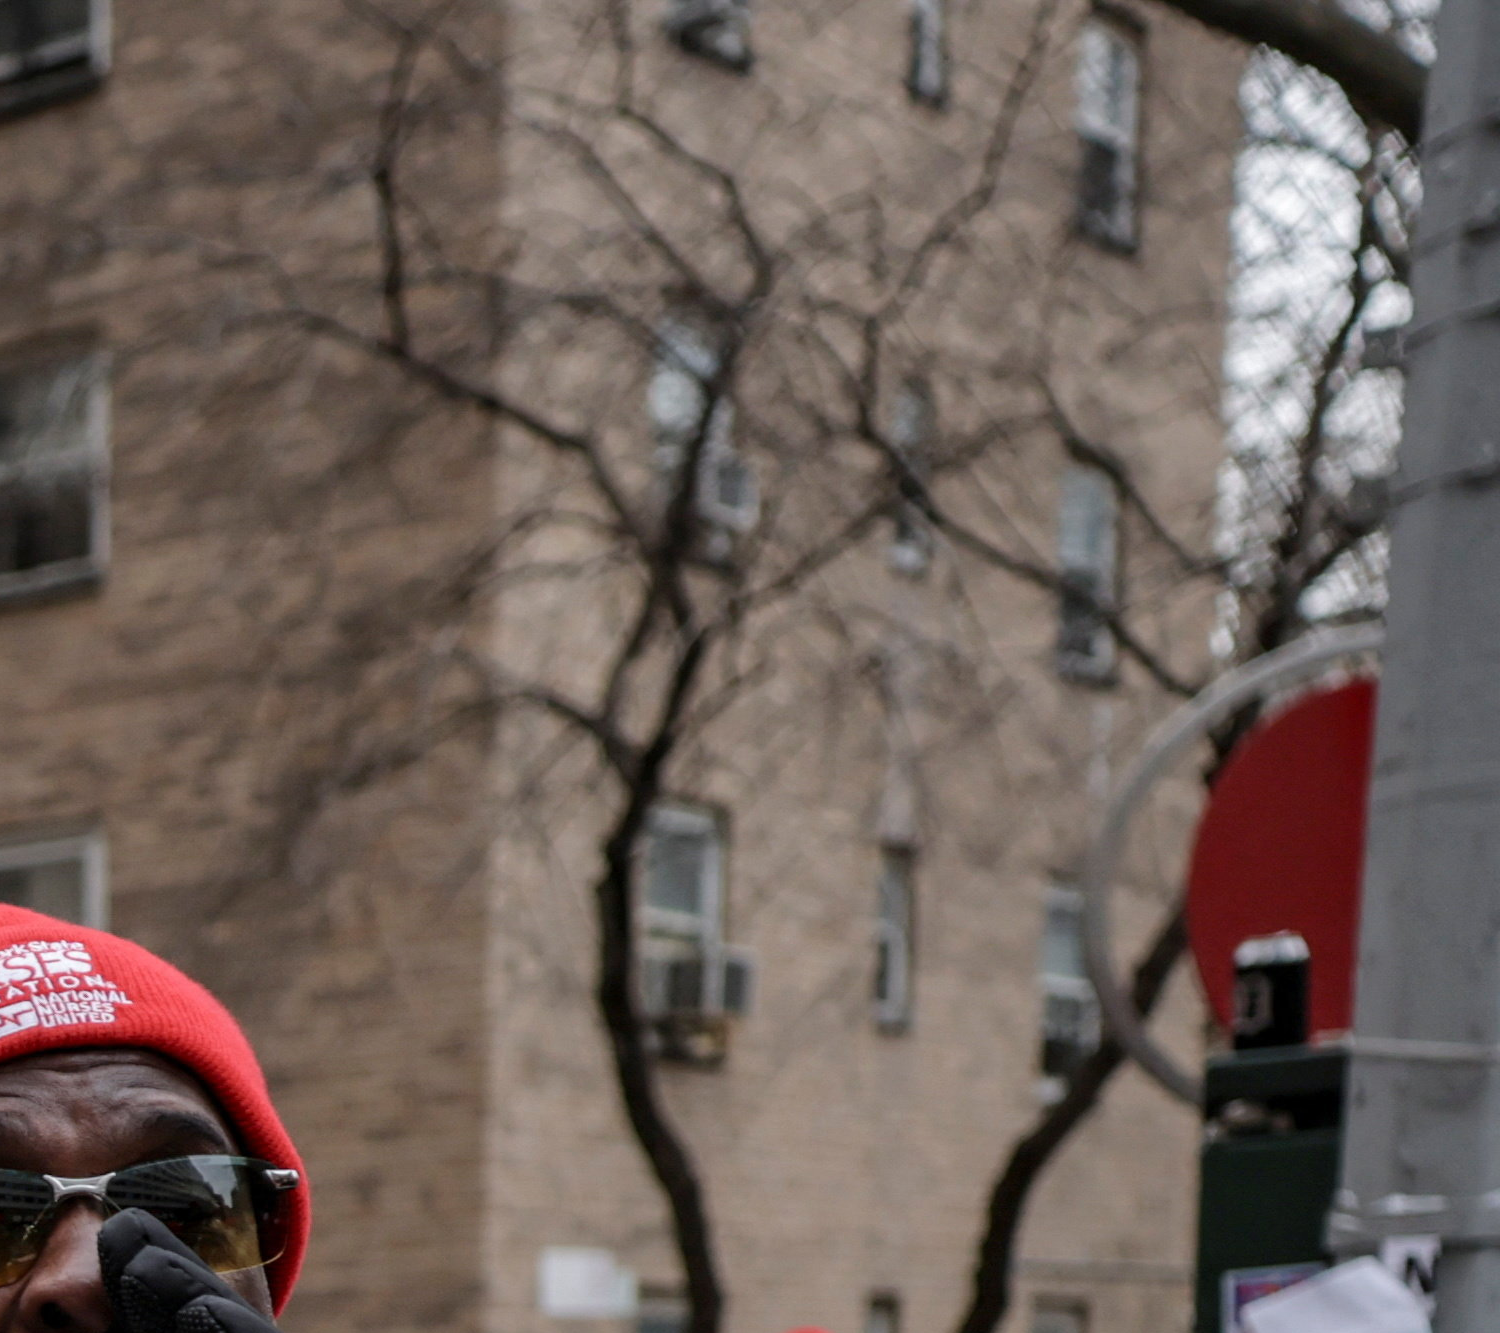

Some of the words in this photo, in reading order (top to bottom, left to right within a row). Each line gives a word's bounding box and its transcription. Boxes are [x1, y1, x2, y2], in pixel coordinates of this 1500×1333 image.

[28, 940, 85, 952] State
[32, 990, 132, 1005] NATIONAL
[38, 1002, 115, 1016] NURSES
[40, 1011, 115, 1028] UNITED
